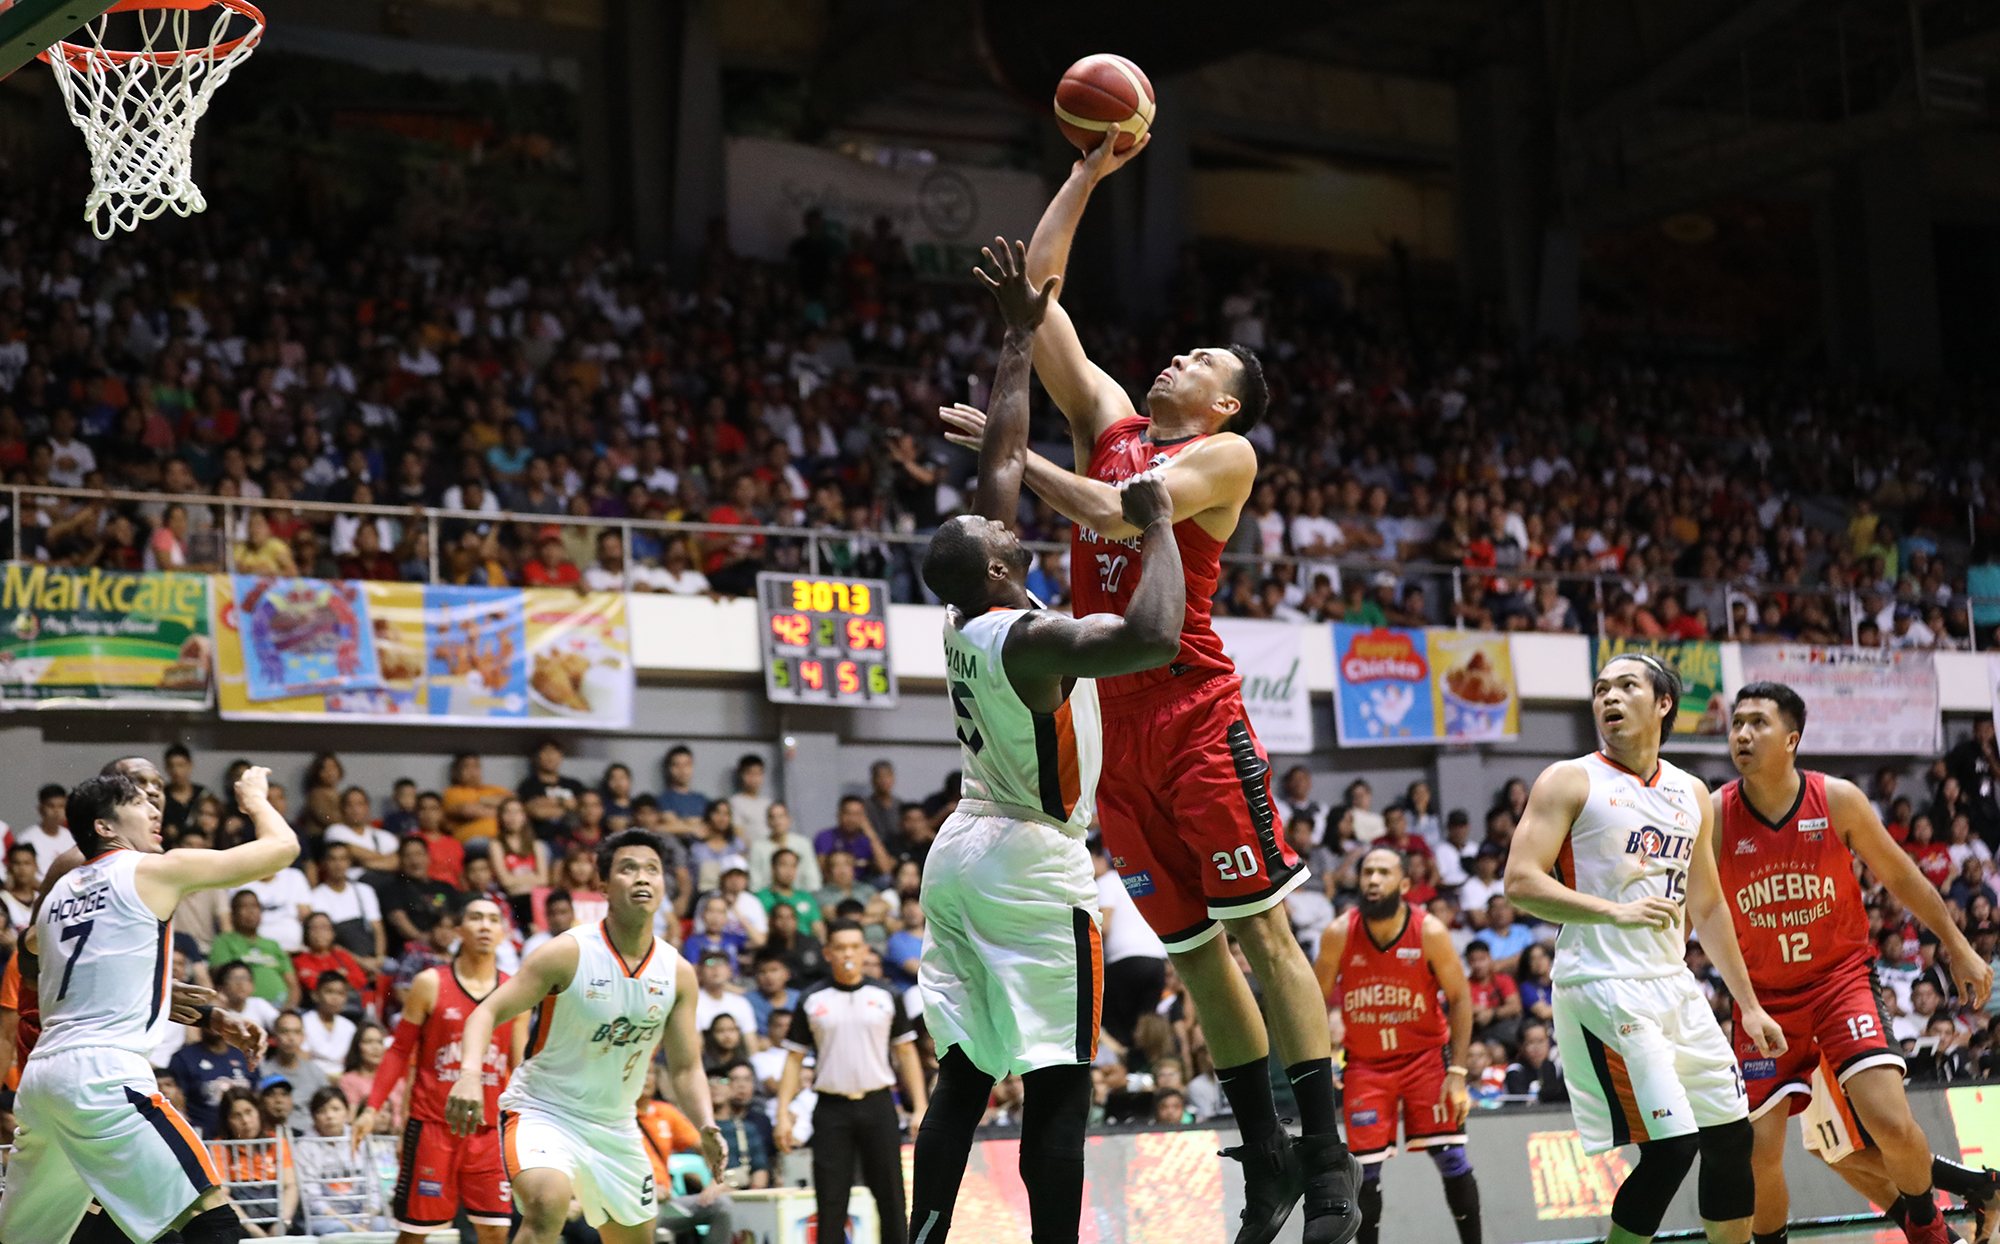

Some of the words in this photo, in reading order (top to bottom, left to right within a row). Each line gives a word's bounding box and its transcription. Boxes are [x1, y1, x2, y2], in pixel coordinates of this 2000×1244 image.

[2, 565, 202, 612] Markcafe
[771, 613, 811, 647] 42
[817, 618, 834, 647] 2
[846, 617, 886, 650] 54
[800, 660, 823, 690] 4
[837, 661, 860, 694] 5
[868, 664, 888, 694] 6
[1345, 656, 1421, 681] Chicken
[1212, 844, 1259, 881] 20
[47, 886, 110, 925] HODGE
[1736, 872, 1837, 915] GINEBRA
[1748, 911, 1778, 930] SAN
[1781, 900, 1832, 929] MIGUEL
[56, 919, 95, 1003] 7
[1777, 931, 1813, 964] 12
[1344, 983, 1428, 1014] GINEBRA
[1351, 1011, 1377, 1024] SAN
[1847, 1013, 1878, 1041] 12
[1378, 1028, 1399, 1051] 11
[1432, 1103, 1449, 1125] 11
[1652, 1108, 1673, 1120] PBA
[1816, 1119, 1840, 1150] 11
